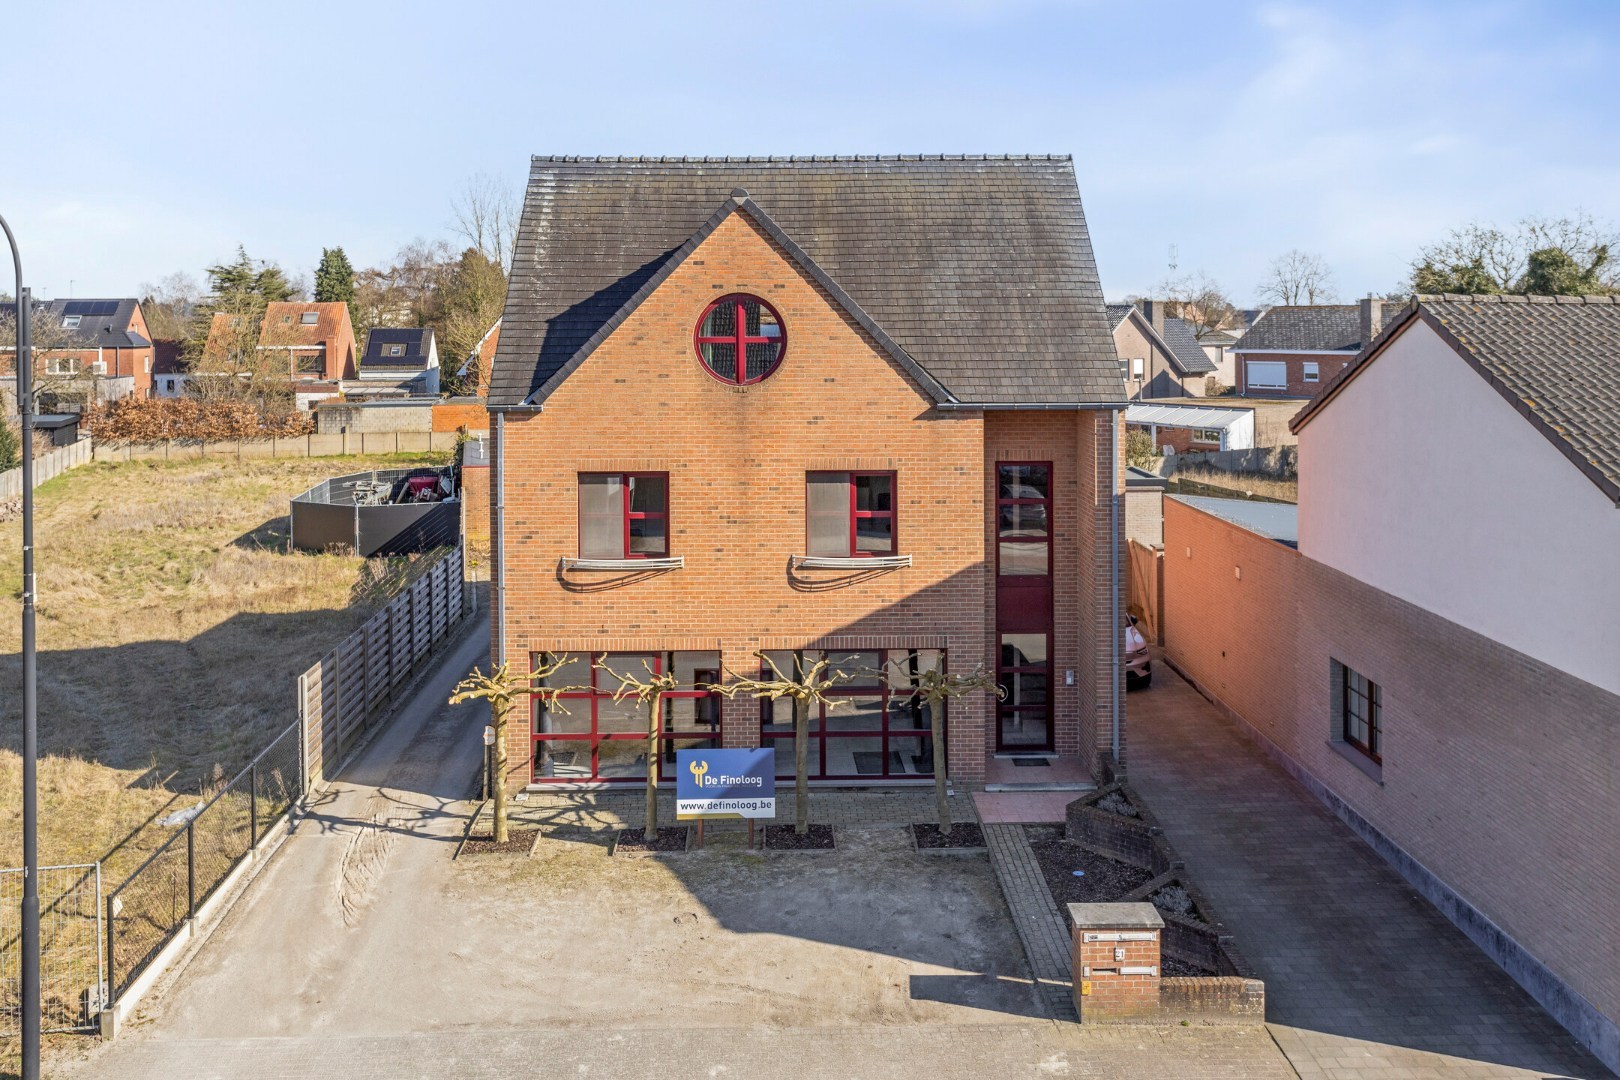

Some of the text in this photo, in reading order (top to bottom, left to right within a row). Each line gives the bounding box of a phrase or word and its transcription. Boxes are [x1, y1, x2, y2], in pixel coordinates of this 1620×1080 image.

[705, 775, 762, 787] De Finoloog
[680, 801, 772, 810] www.definoloog.be
